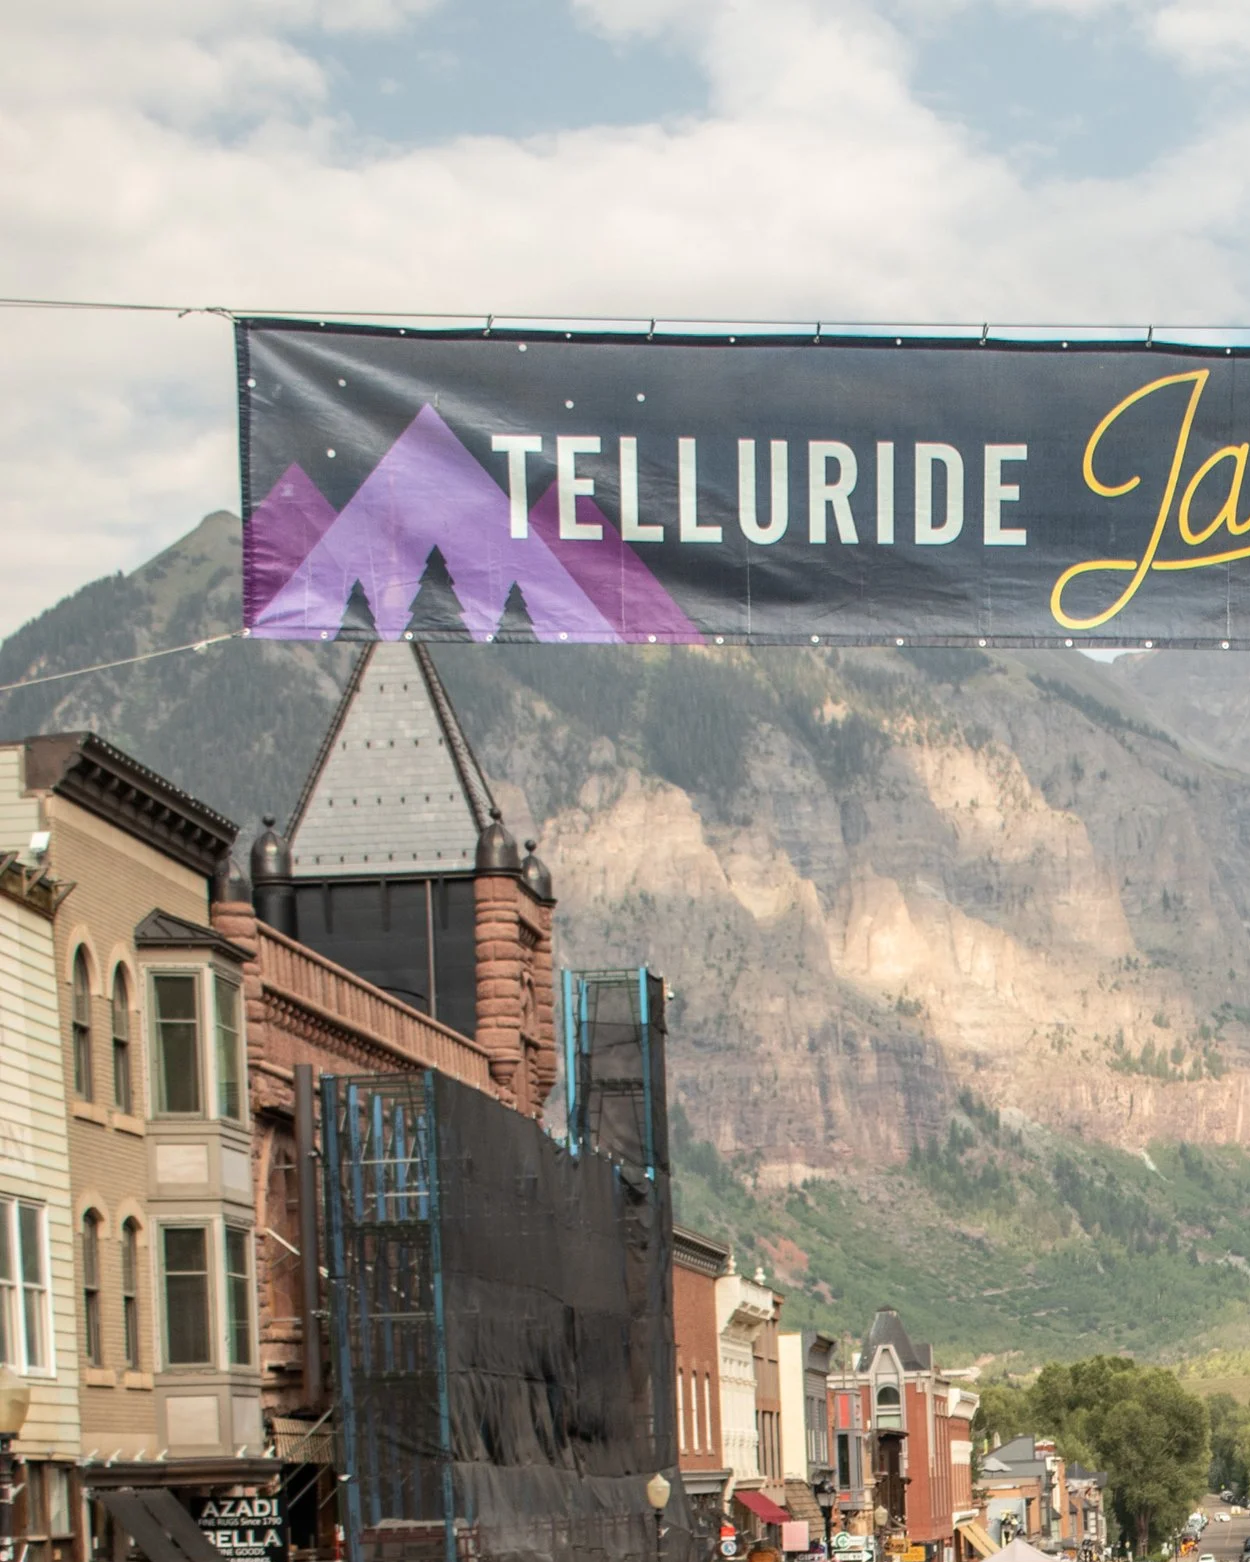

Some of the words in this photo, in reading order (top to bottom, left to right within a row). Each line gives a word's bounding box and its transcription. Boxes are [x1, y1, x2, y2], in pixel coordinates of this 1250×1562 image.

[488, 433, 1030, 546] TELLURIDE
[201, 1499, 278, 1518] AZADI
[235, 1547, 266, 1556] GOODS
